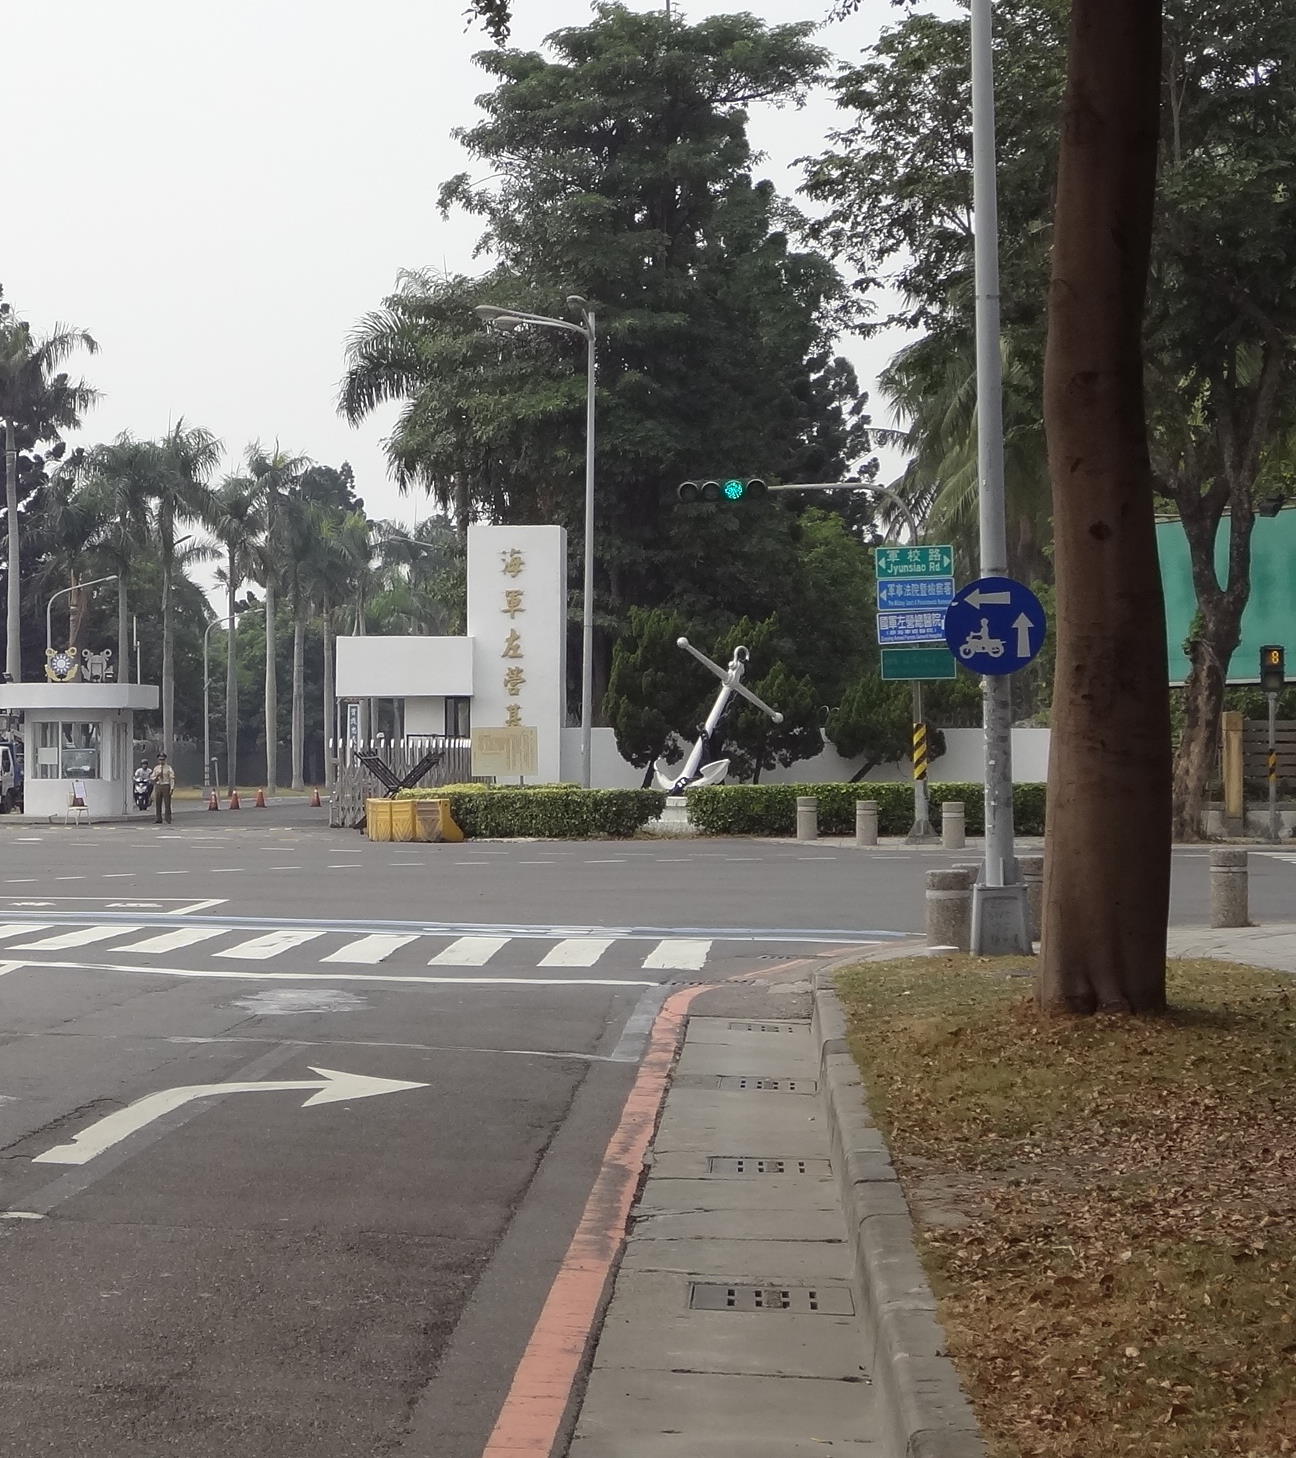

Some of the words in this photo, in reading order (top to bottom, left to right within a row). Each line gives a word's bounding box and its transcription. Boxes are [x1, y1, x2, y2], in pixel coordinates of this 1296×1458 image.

[886, 548, 941, 562] 軍校路
[887, 563, 926, 576] Jyunsiao
[1271, 650, 1279, 664] 8
